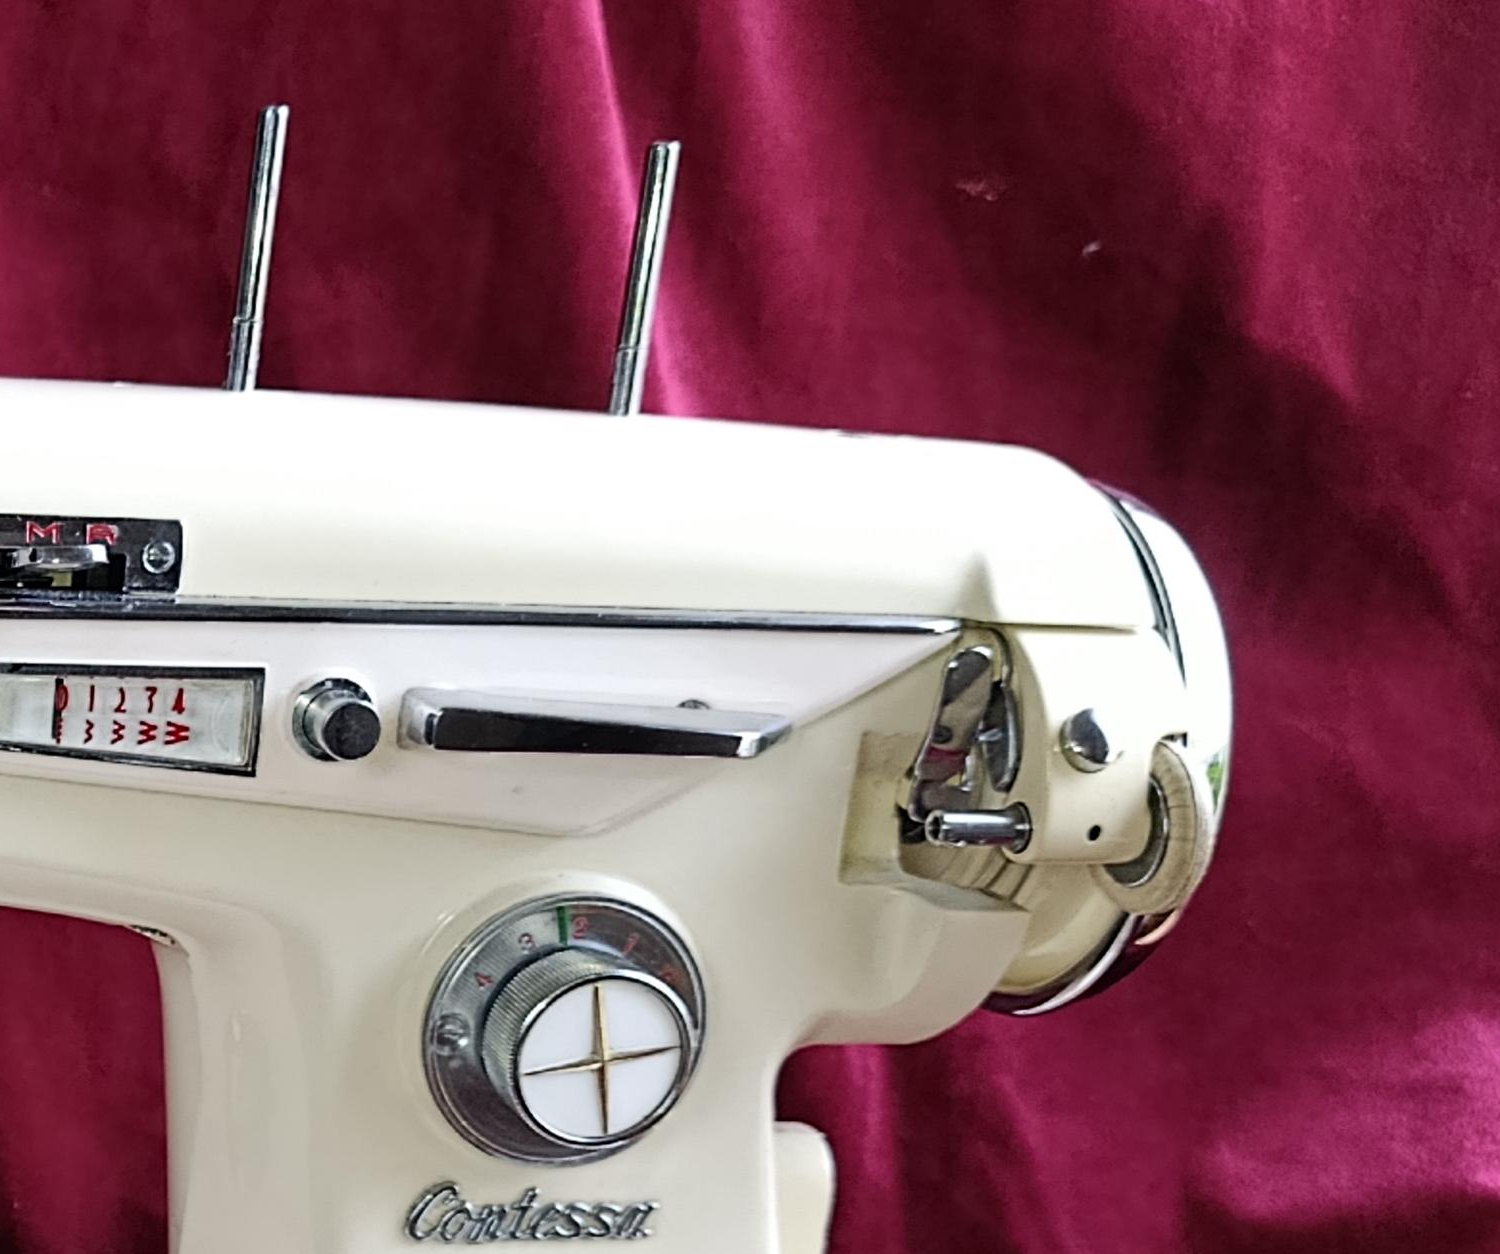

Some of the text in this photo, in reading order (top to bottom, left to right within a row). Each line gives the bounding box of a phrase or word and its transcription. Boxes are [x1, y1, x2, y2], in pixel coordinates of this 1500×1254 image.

[26, 520, 63, 544] M
[86, 523, 119, 546] R
[89, 685, 95, 712] 1
[113, 686, 127, 713] 2
[572, 915, 589, 940] 2
[404, 1180, 661, 1243] Contessa
